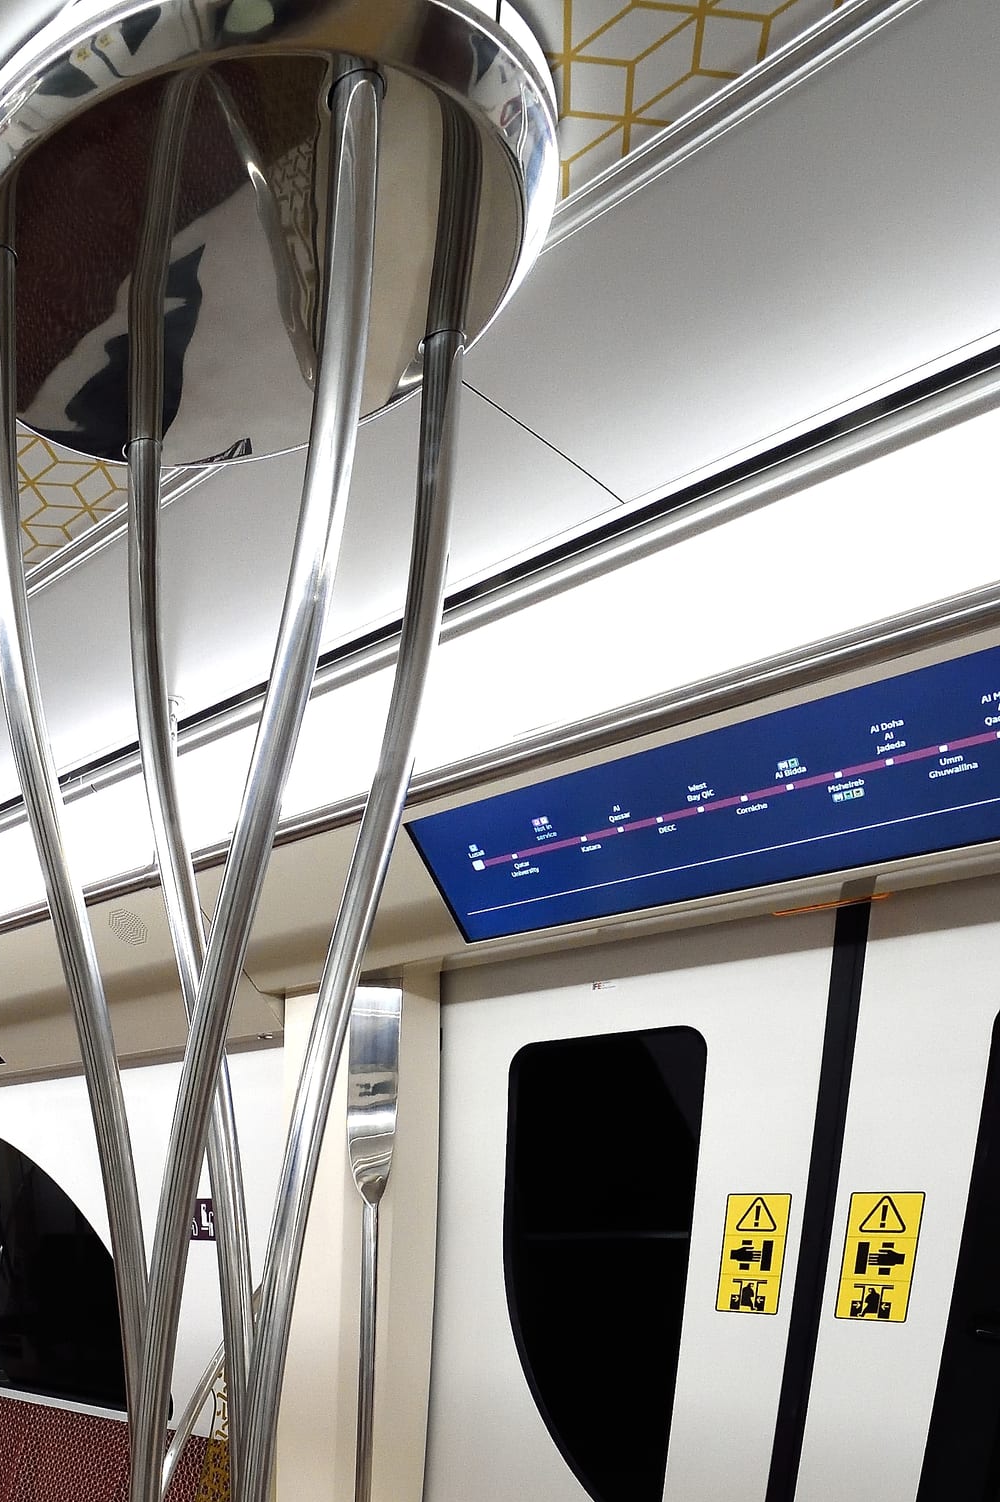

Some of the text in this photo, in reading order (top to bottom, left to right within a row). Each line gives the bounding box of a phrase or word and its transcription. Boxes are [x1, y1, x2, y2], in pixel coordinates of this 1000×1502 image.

[870, 719, 905, 734] Al Doha
[884, 731, 894, 741] Al
[876, 740, 906, 755] Jadeda
[939, 755, 964, 766] Umm
[775, 766, 807, 780] Al Bidda
[687, 782, 708, 792] West
[827, 778, 865, 793] Msheireb
[686, 793, 701, 803] Bay
[612, 804, 621, 813] Al
[736, 803, 768, 815] Corniche
[658, 824, 677, 834] DECC
